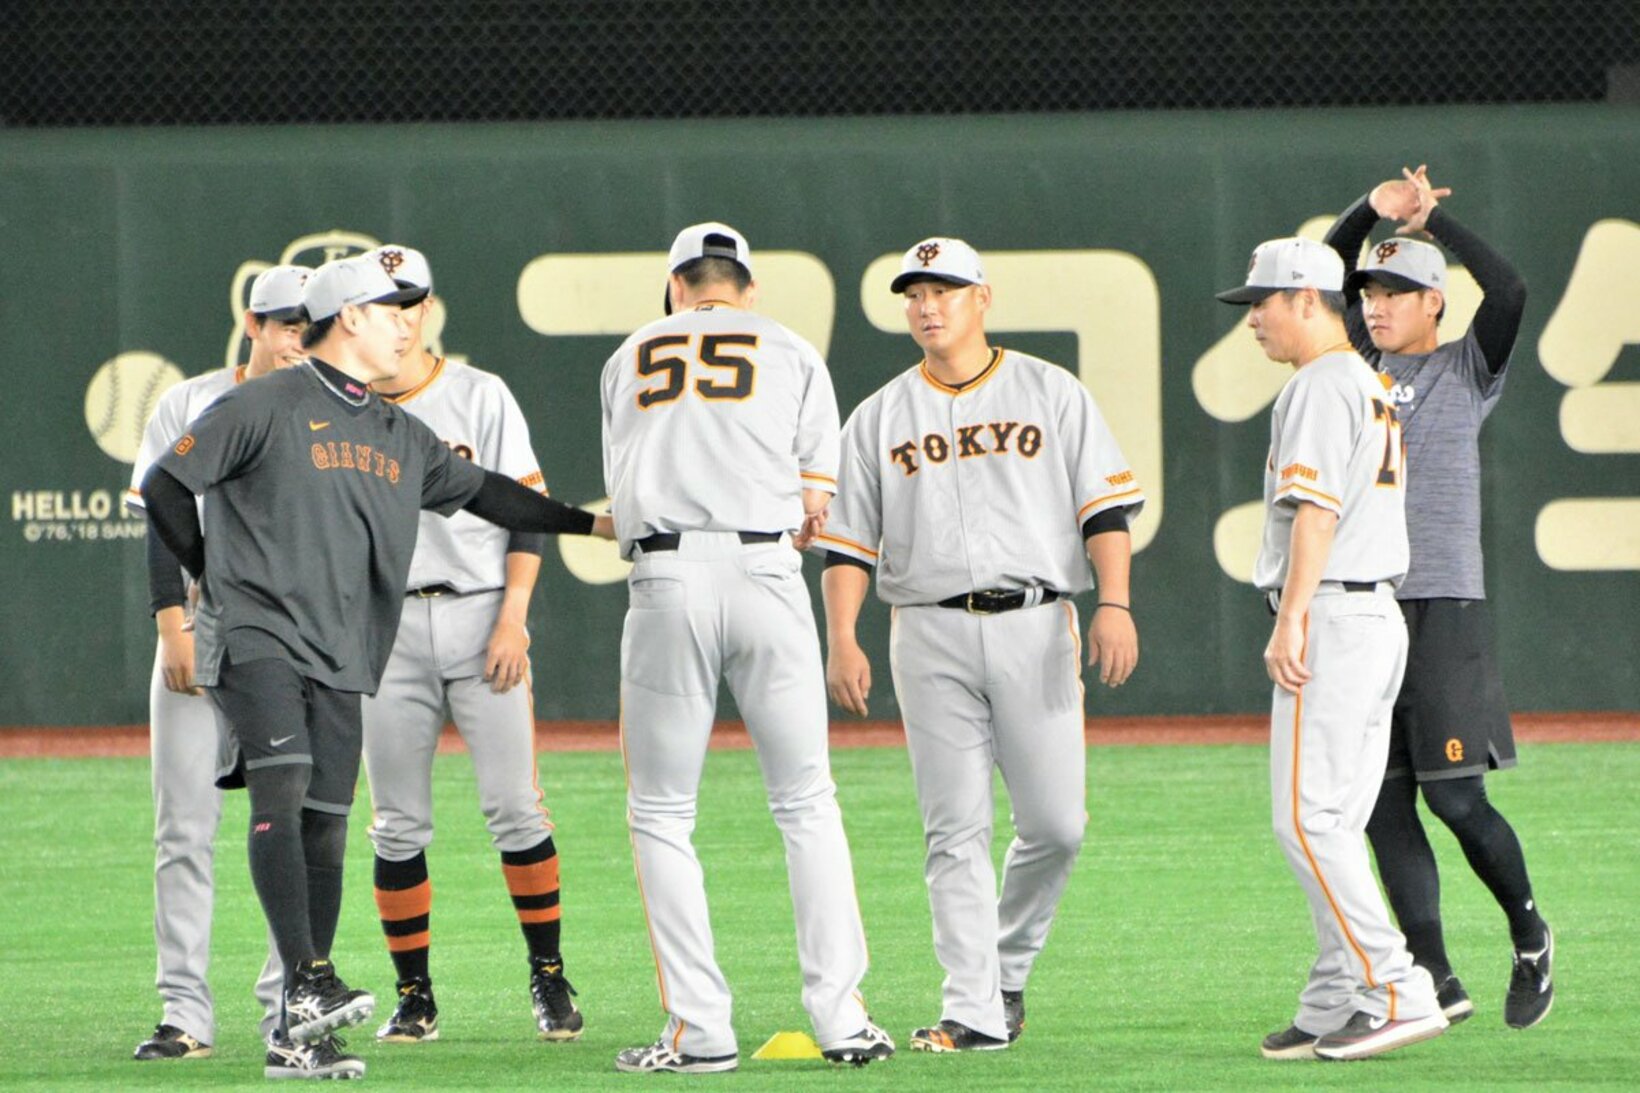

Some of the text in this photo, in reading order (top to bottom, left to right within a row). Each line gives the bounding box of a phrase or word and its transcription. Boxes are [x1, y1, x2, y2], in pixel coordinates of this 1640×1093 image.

[636, 332, 758, 411] 55
[310, 441, 400, 483] GIANTS
[890, 422, 1043, 477] TOKYO
[11, 490, 111, 521] HELLO
[1445, 738, 1464, 762] G
